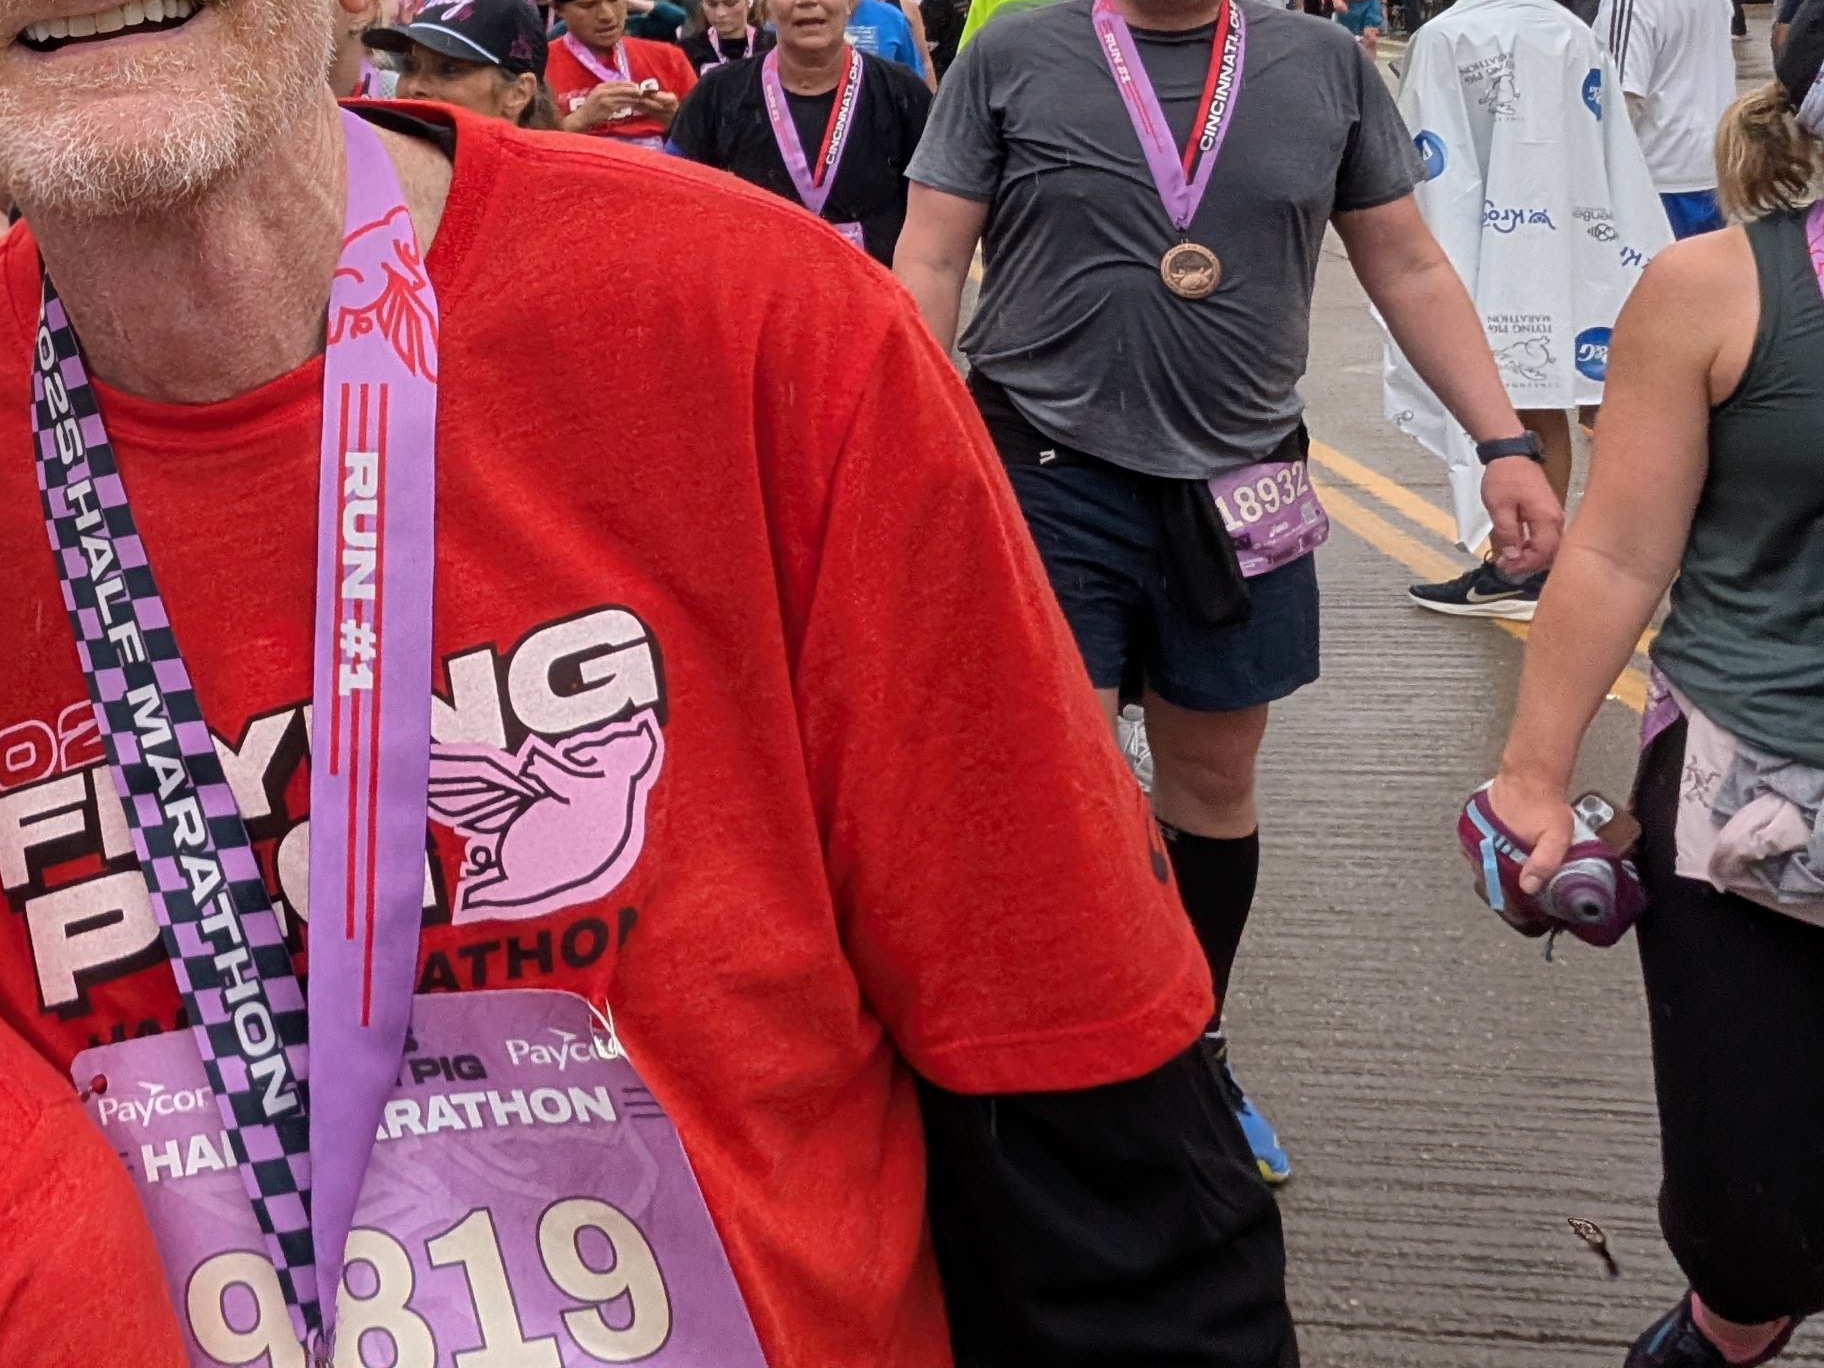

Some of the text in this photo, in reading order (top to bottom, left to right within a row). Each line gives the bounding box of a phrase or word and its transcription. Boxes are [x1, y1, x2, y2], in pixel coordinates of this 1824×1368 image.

[1104, 32, 1124, 64] RUN
[1199, 33, 1240, 151] CINCINNATI,
[1481, 199, 1525, 233] Krog
[1215, 461, 1309, 532] 18932
[338, 451, 379, 697] RUN #1
[38, 325, 84, 465] 025
[67, 479, 146, 664] HALF
[126, 682, 298, 1118] MARATHON
[408, 1054, 488, 1085] PIG
[505, 1027, 617, 1072] Payc
[98, 1082, 211, 1130] Paycor
[140, 1085, 618, 1183] HA RATHON
[185, 1195, 674, 1368] 9819
